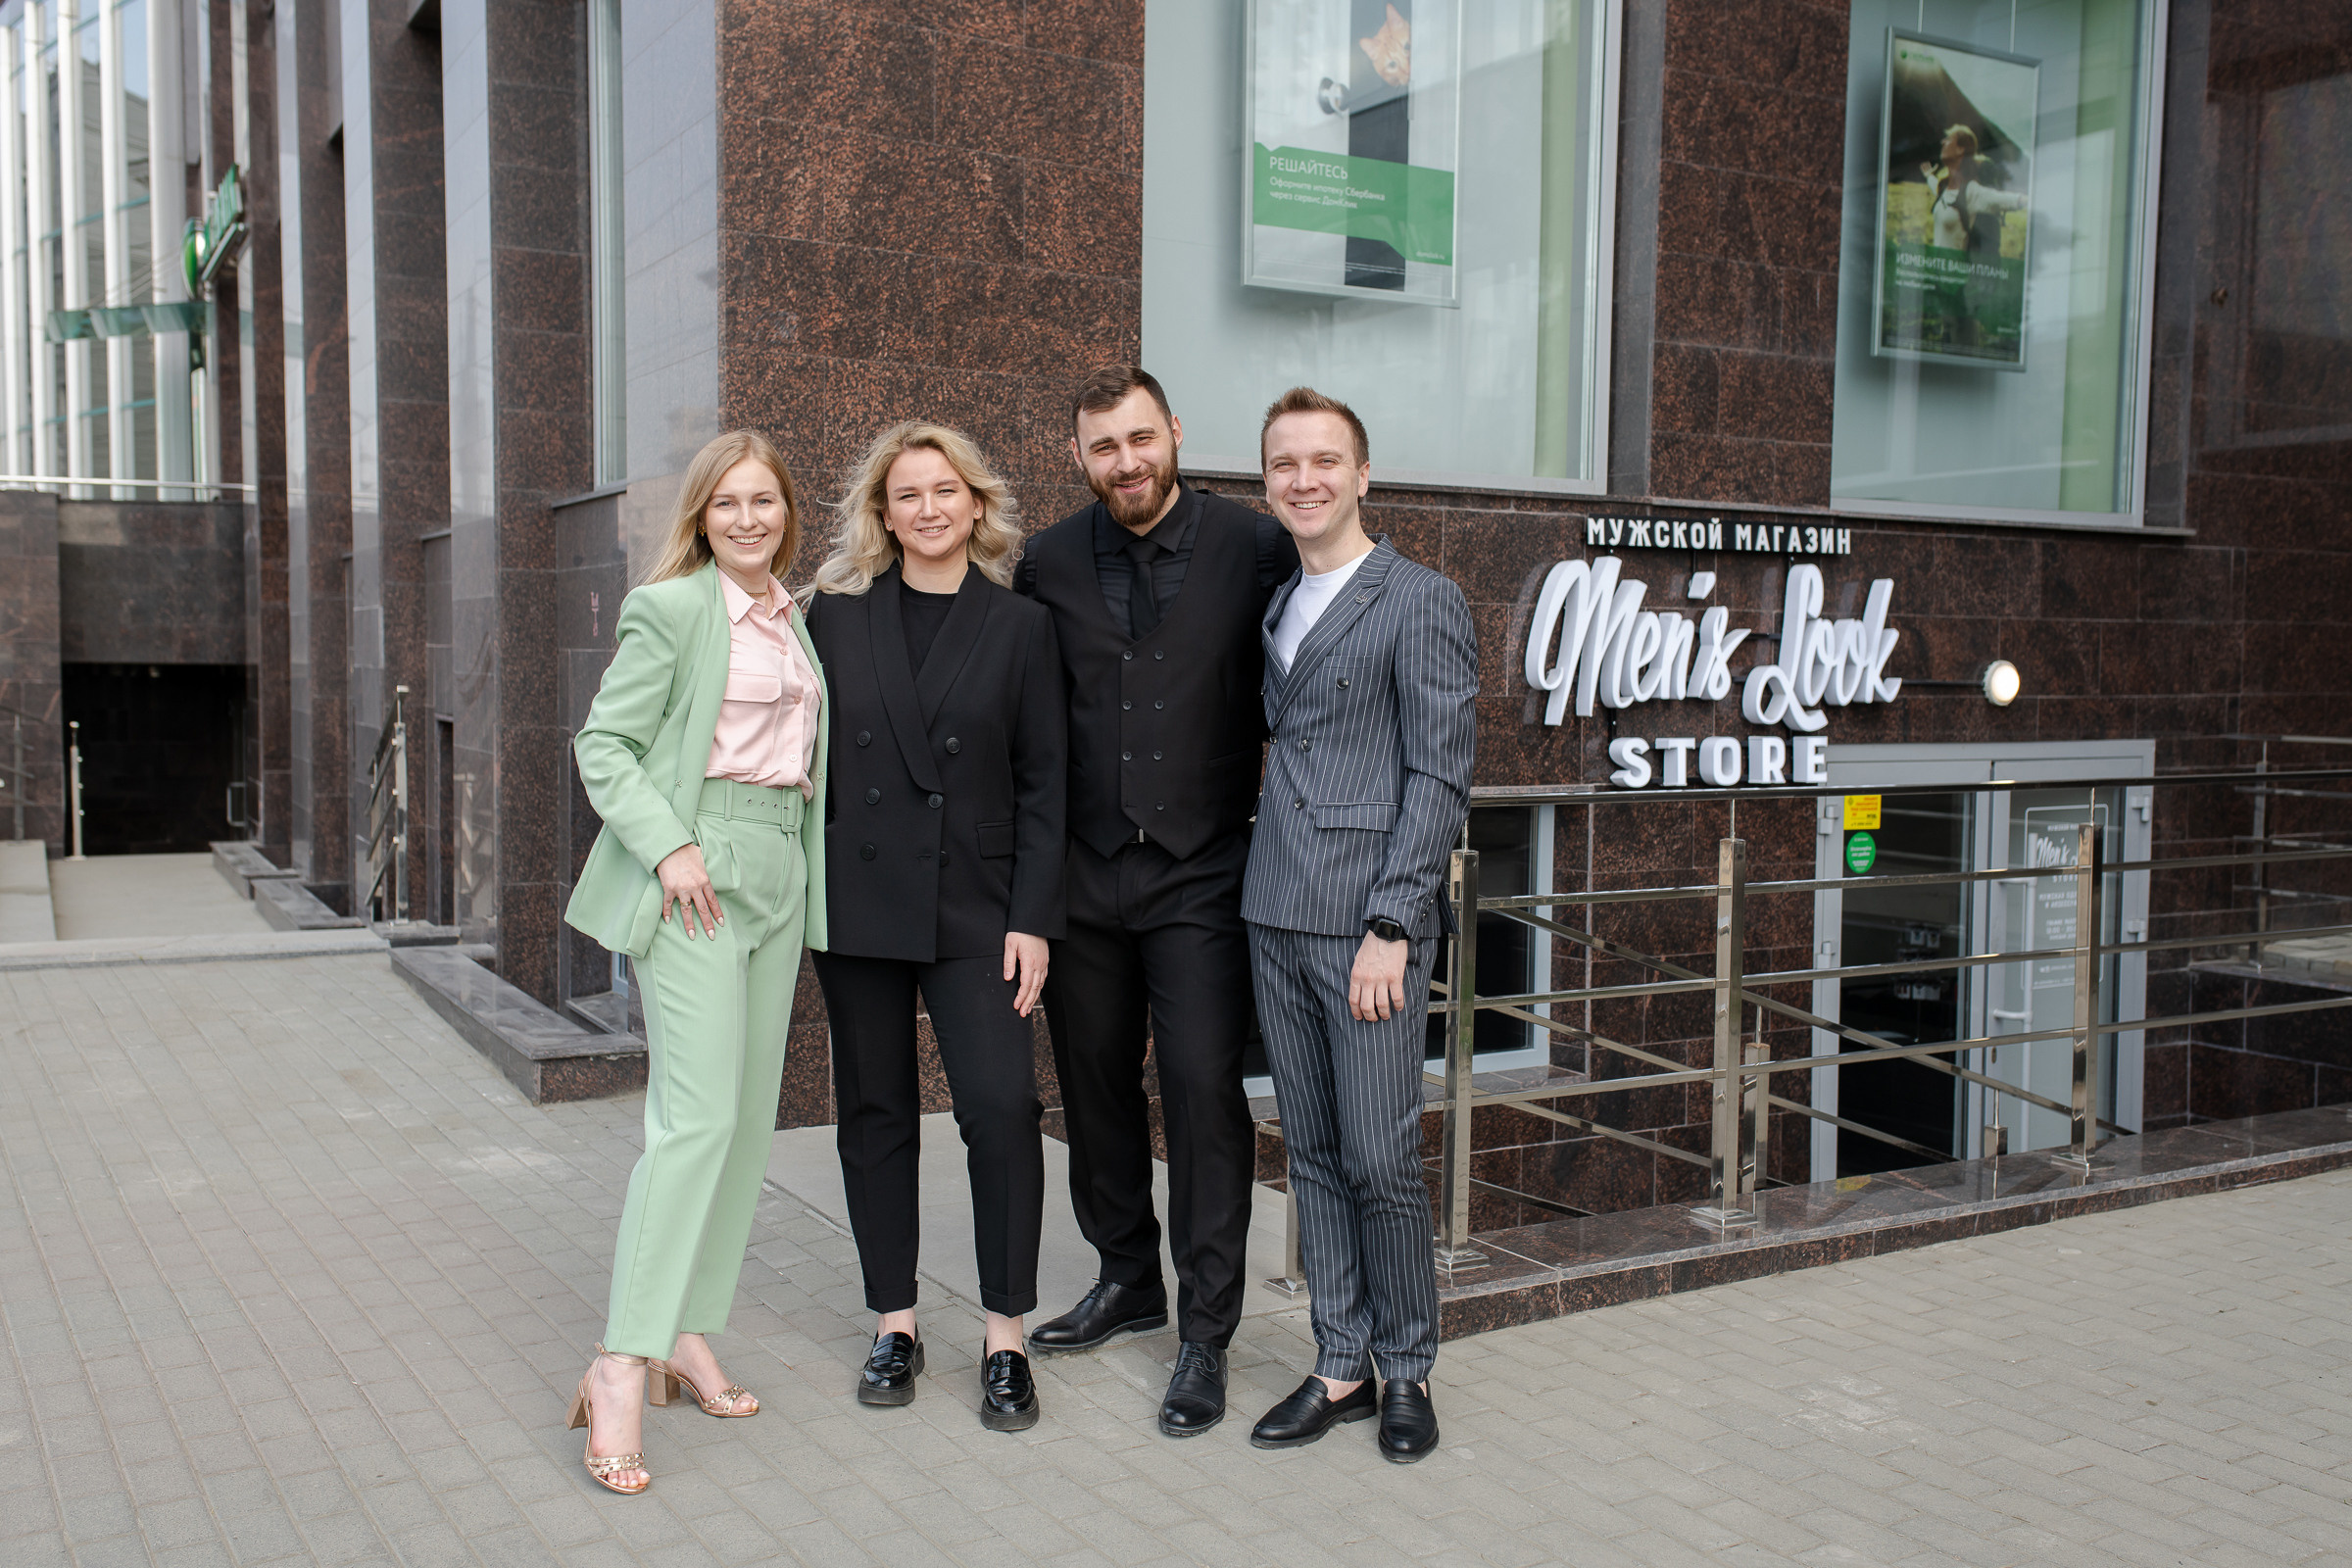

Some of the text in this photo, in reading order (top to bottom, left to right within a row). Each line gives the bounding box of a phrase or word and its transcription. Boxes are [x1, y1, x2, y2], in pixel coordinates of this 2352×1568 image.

[1269, 156, 1348, 179] РЕШАЙТЕСЬ
[1345, 186, 1386, 201] Сбербанка
[1895, 252, 1946, 271] ИЗМЕНИТЕ
[1947, 259, 1976, 275] ВАШИ
[1976, 264, 2009, 281] ПЛАНЫ
[1587, 517, 1851, 555] МУЖСКОЙ МАГАЗИН
[1525, 556, 1903, 732] Men's Look
[1608, 735, 1829, 788] STORE
